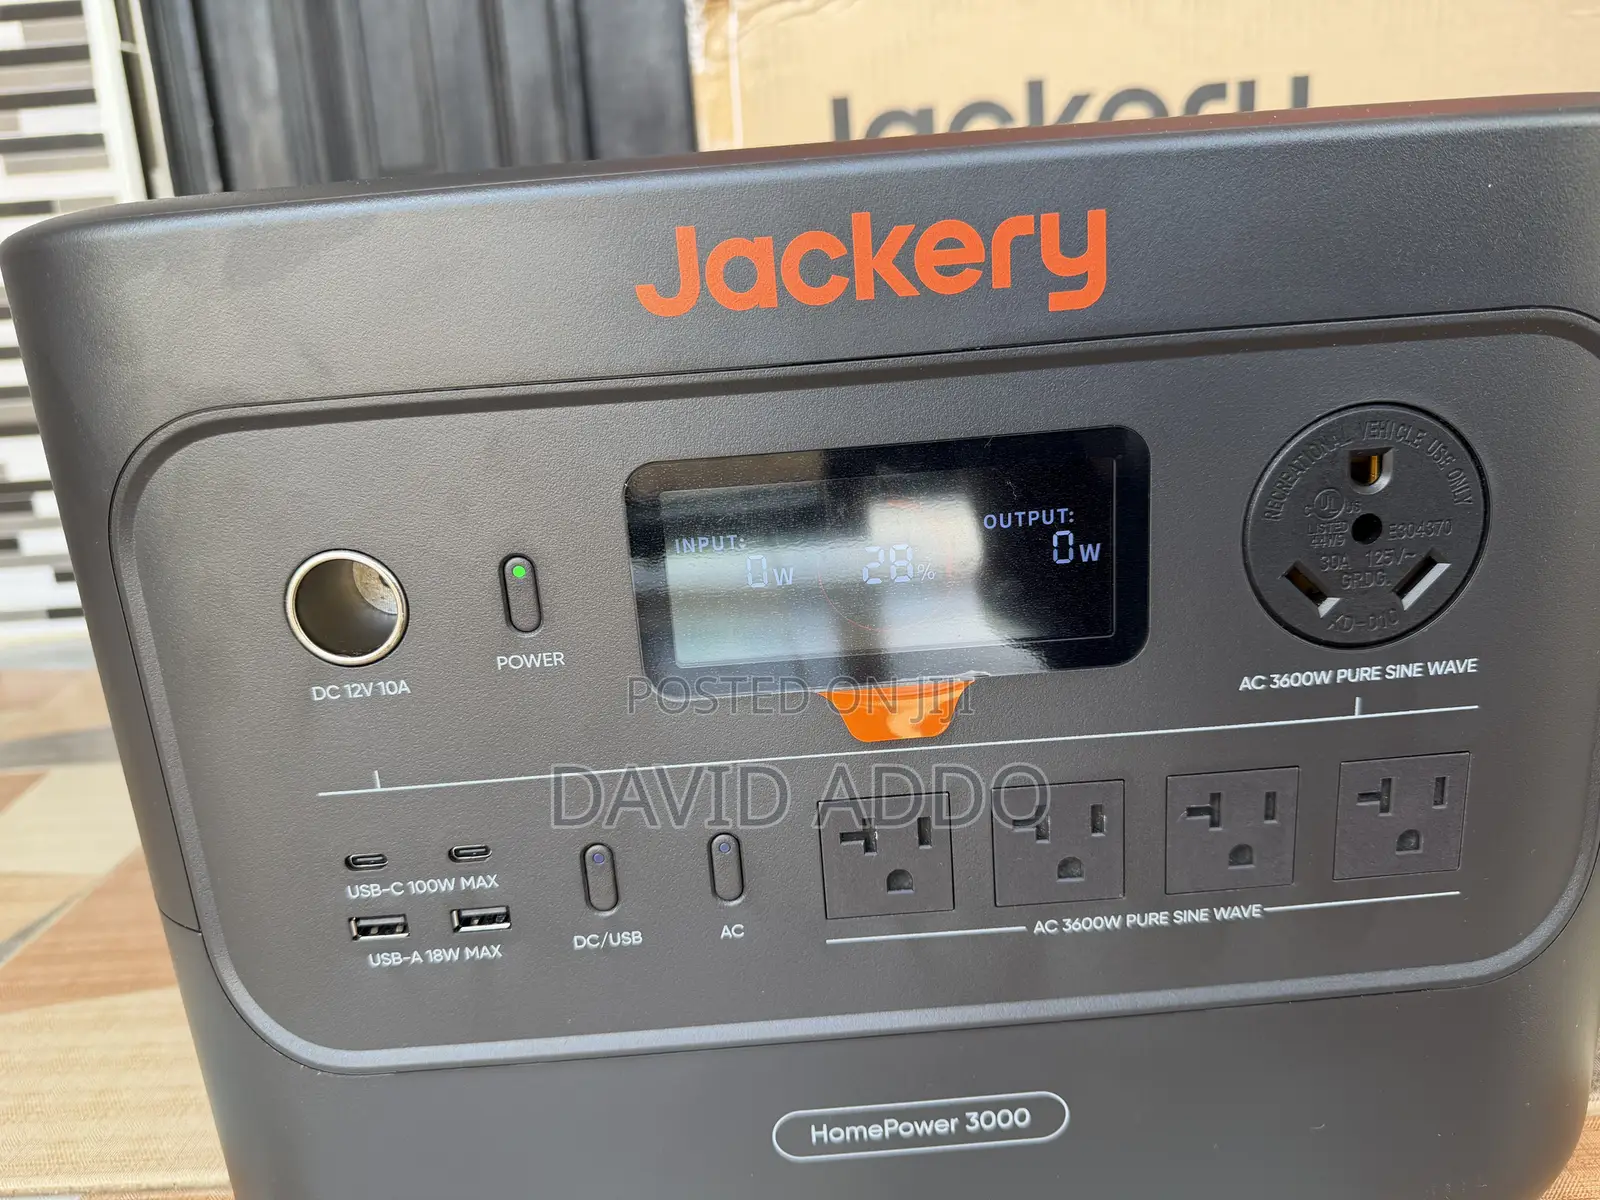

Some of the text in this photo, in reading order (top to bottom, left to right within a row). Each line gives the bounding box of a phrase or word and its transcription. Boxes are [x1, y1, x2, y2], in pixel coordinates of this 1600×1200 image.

[635, 208, 1107, 318] Jackery
[1358, 419, 1428, 449] VEHICLE
[1427, 438, 1457, 471] USE
[1447, 467, 1474, 506] ONLY
[983, 508, 1074, 529] OUTPUT:
[1307, 521, 1350, 536] LISTED
[1388, 517, 1453, 541] E304370
[674, 534, 747, 555] INPUT:
[1319, 553, 1352, 572] 30A
[496, 651, 566, 670] POWER
[1238, 657, 1479, 692] AC 3600W PURE SINE WAVE
[311, 679, 412, 701] DC 12V 10A
[346, 873, 500, 899] USB-C 100W MAX
[1033, 903, 1263, 935] AC 3600W PURE SINE WAVE
[572, 930, 643, 950] DC/USB
[720, 924, 745, 940] AC
[368, 944, 503, 968] USB-A 18W MAX
[810, 1107, 1032, 1146] HomePower 3000
